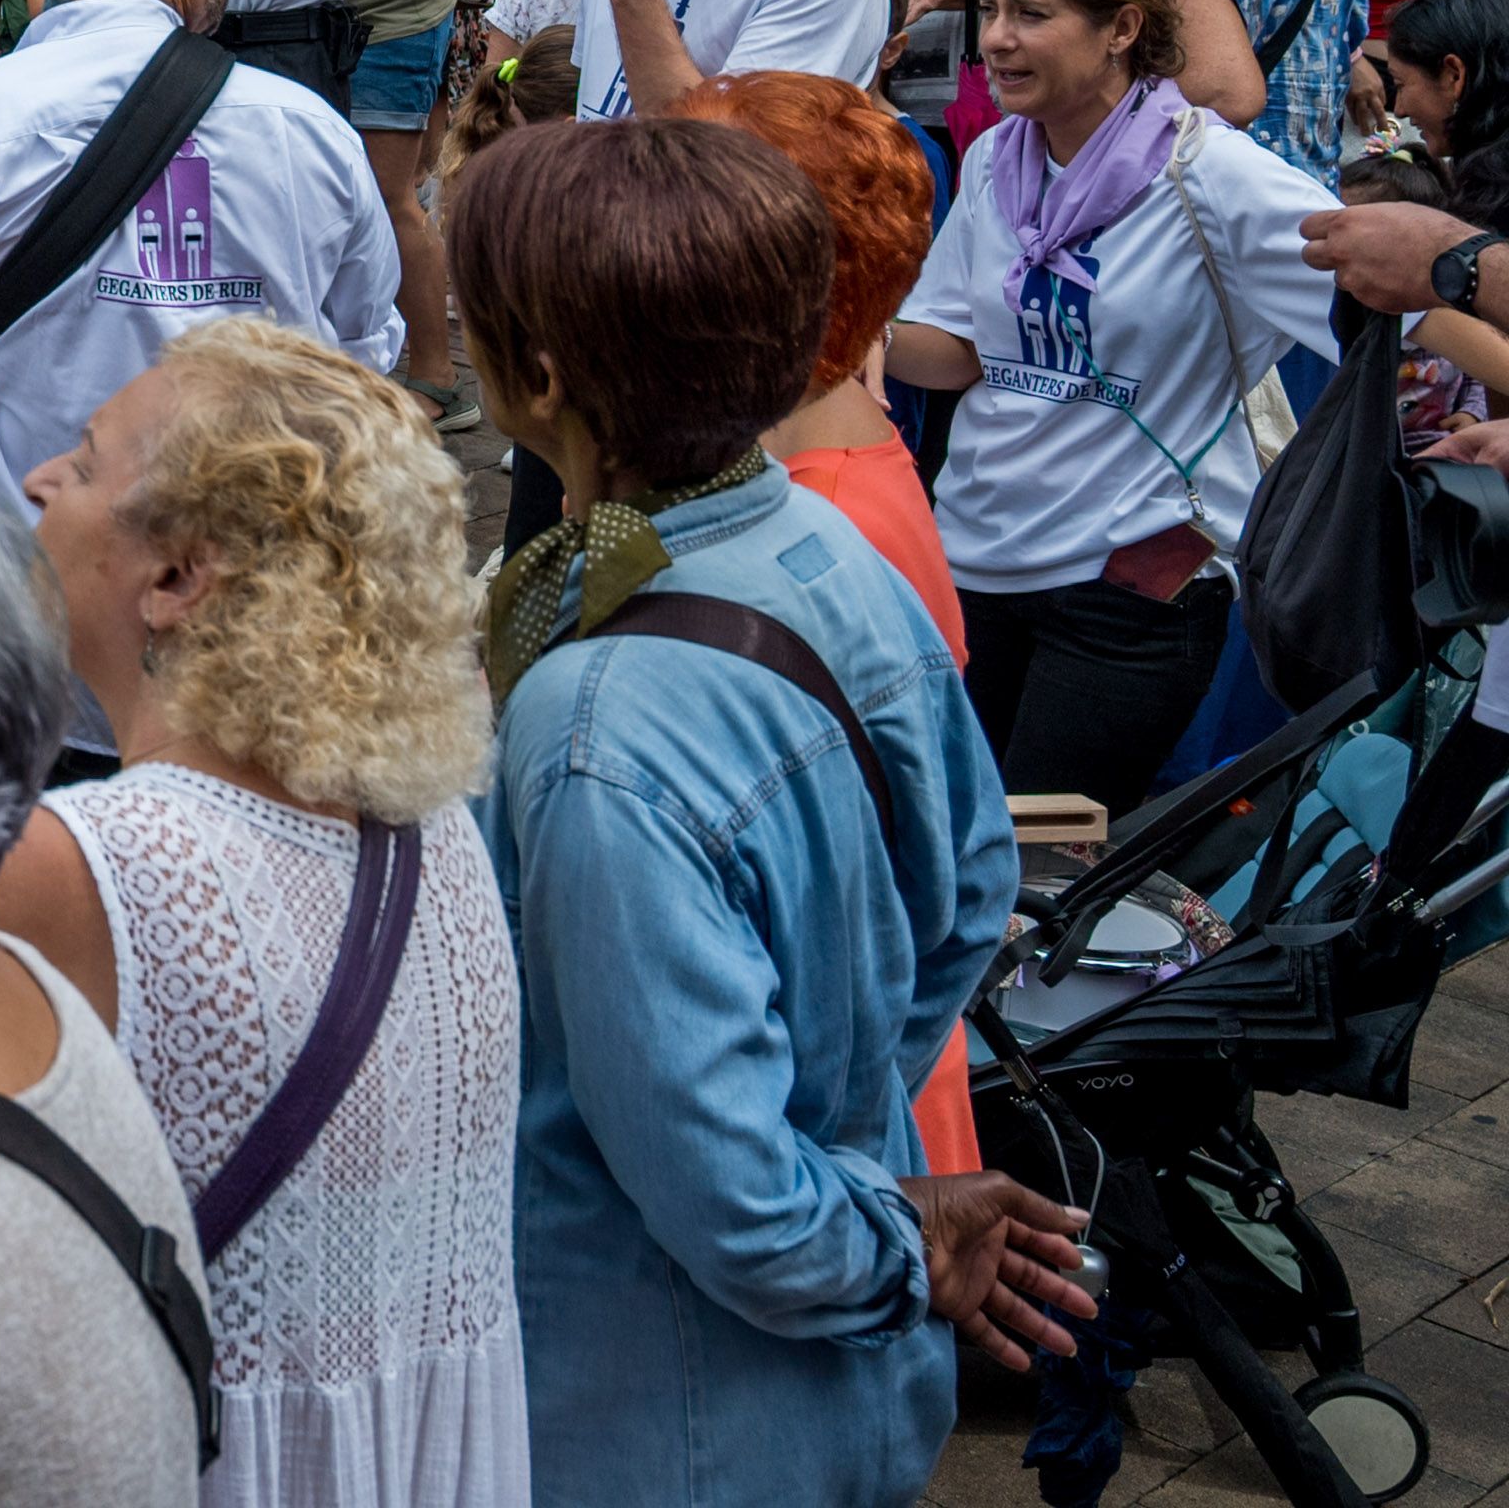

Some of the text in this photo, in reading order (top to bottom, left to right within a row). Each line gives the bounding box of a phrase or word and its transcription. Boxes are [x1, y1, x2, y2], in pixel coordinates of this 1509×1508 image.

[97, 276, 188, 302] GEGANTERS
[192, 283, 215, 301] DE
[983, 364, 1066, 397] GEGANTERS
[1065, 381, 1091, 400] DE
[1076, 1073, 1134, 1090] YOYO
